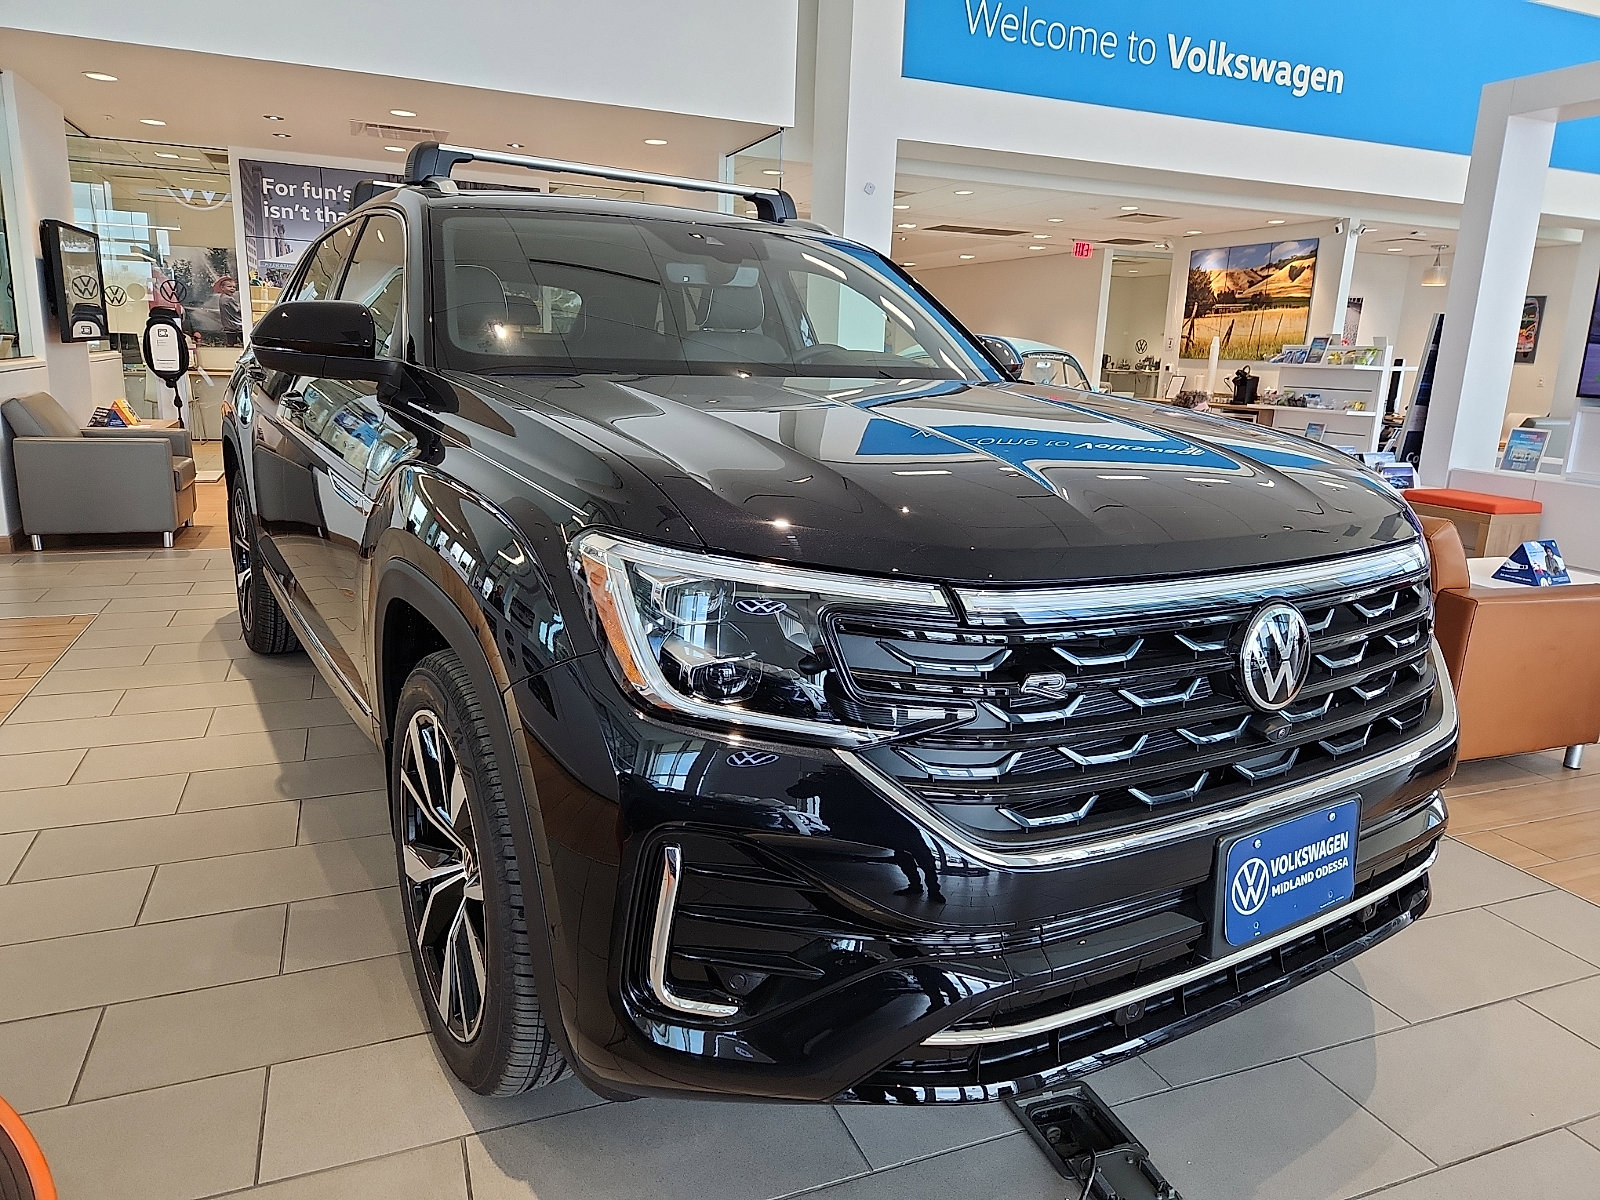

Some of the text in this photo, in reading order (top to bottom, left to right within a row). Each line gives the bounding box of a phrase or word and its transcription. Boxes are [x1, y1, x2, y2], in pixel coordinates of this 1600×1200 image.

[964, 0, 1344, 97] Welcome to Volkswagen
[262, 178, 352, 203] For fun's
[263, 201, 310, 221] isn't
[1270, 831, 1349, 877] VOLKSWAGEN
[1271, 857, 1349, 898] MIDLAND ODESSA
